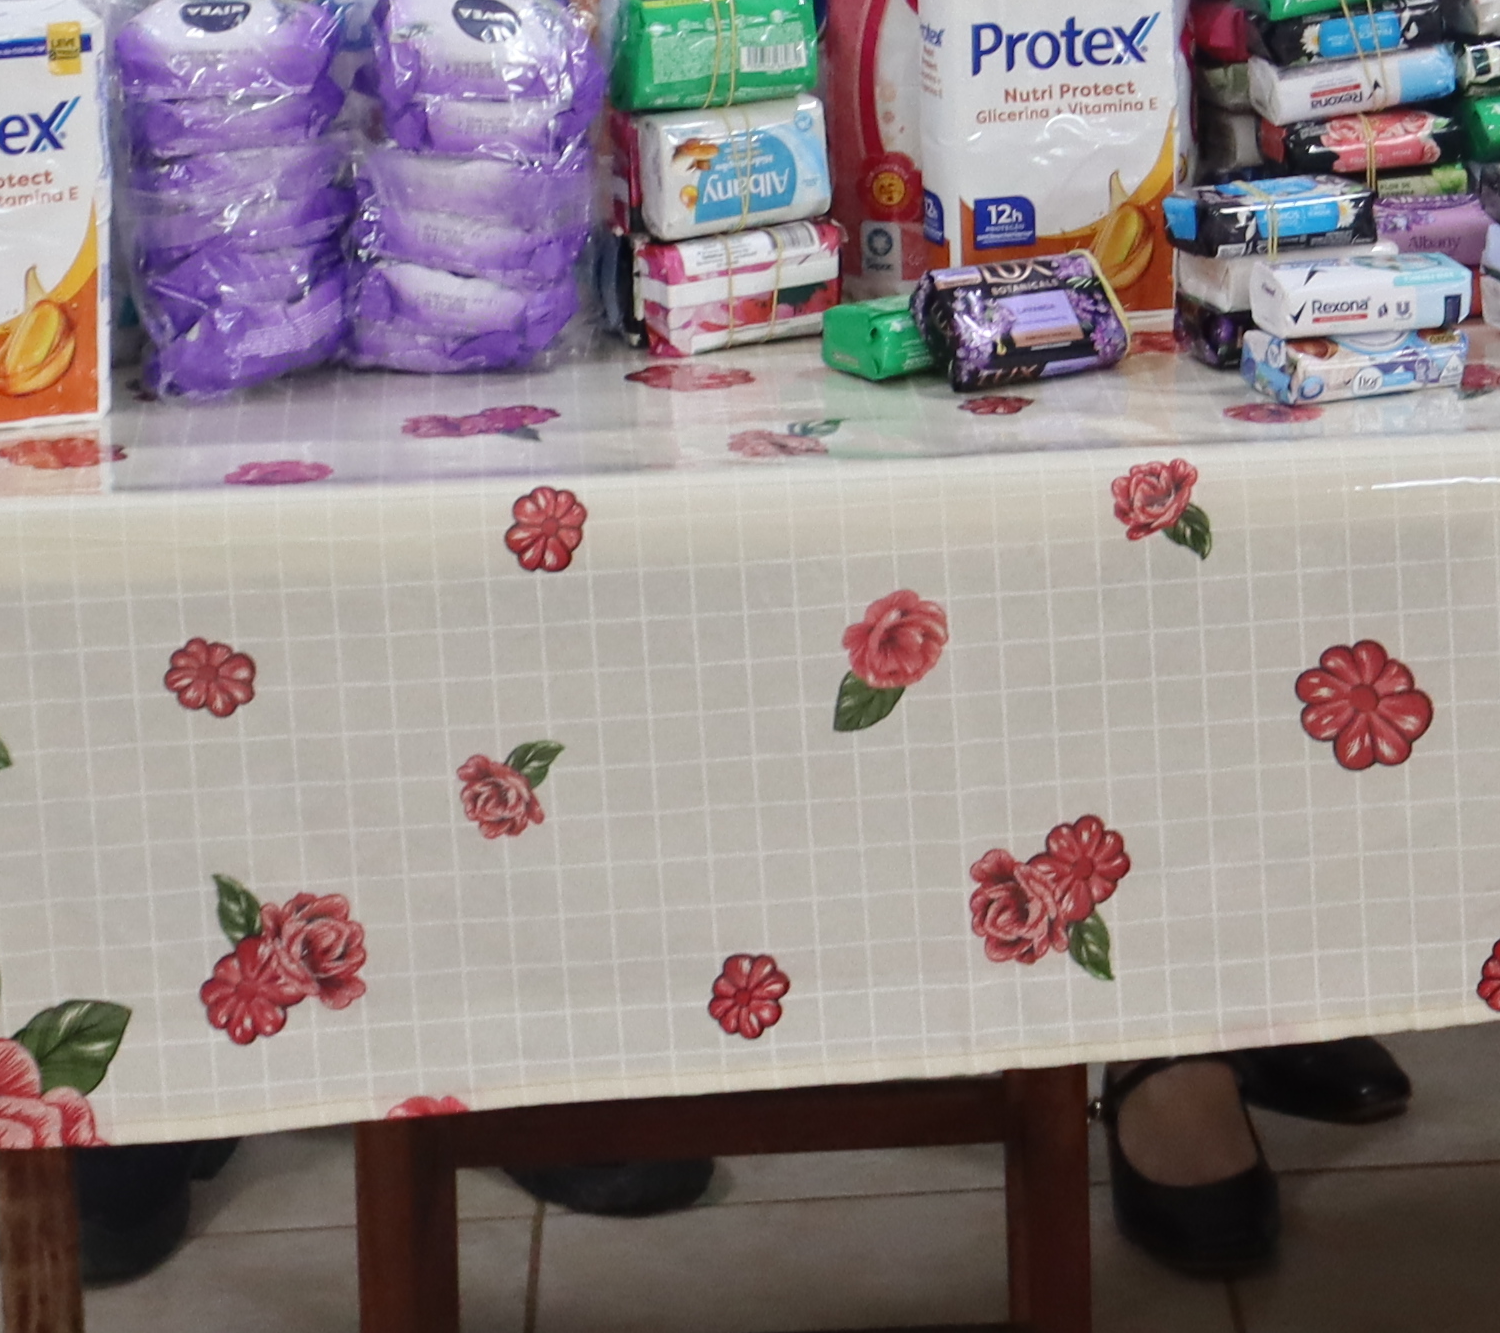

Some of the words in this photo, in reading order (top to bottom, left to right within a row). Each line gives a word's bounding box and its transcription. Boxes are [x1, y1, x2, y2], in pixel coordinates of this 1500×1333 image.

[185, 3, 246, 18] NIVEA
[458, 5, 519, 23] NIVEA
[970, 11, 1161, 77] Protex
[1003, 86, 1053, 104] Nutri
[1059, 80, 1136, 99] Protect
[1310, 90, 1364, 110] Rexona
[975, 105, 1050, 124] Glicerina
[1054, 106, 1064, 117] +
[1068, 99, 1144, 115] Vitamina
[1148, 97, 1158, 110] E
[69, 187, 80, 202] E
[702, 168, 791, 205] Albany
[986, 204, 1024, 225] 12h
[1408, 235, 1460, 252] Albany
[1311, 298, 1370, 315] Rexona
